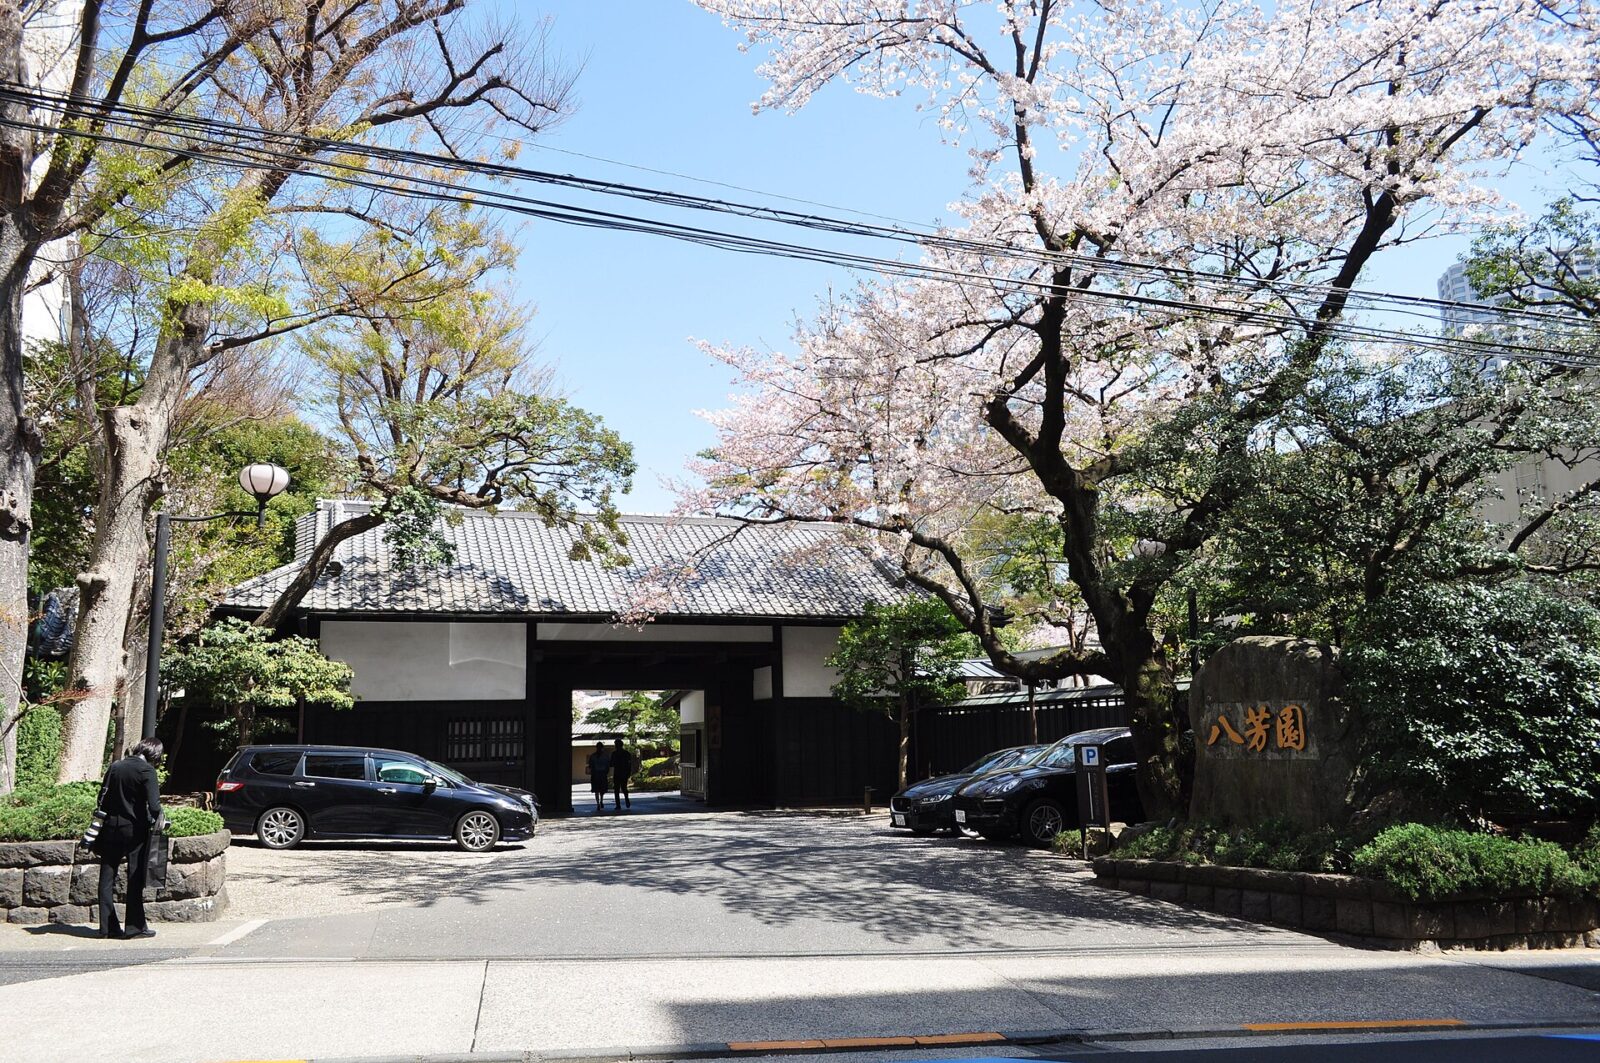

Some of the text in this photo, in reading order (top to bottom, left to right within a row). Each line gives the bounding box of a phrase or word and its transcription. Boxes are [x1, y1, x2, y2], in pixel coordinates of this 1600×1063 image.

[1207, 704, 1305, 752] 八芳園
[1086, 748, 1097, 764] P
